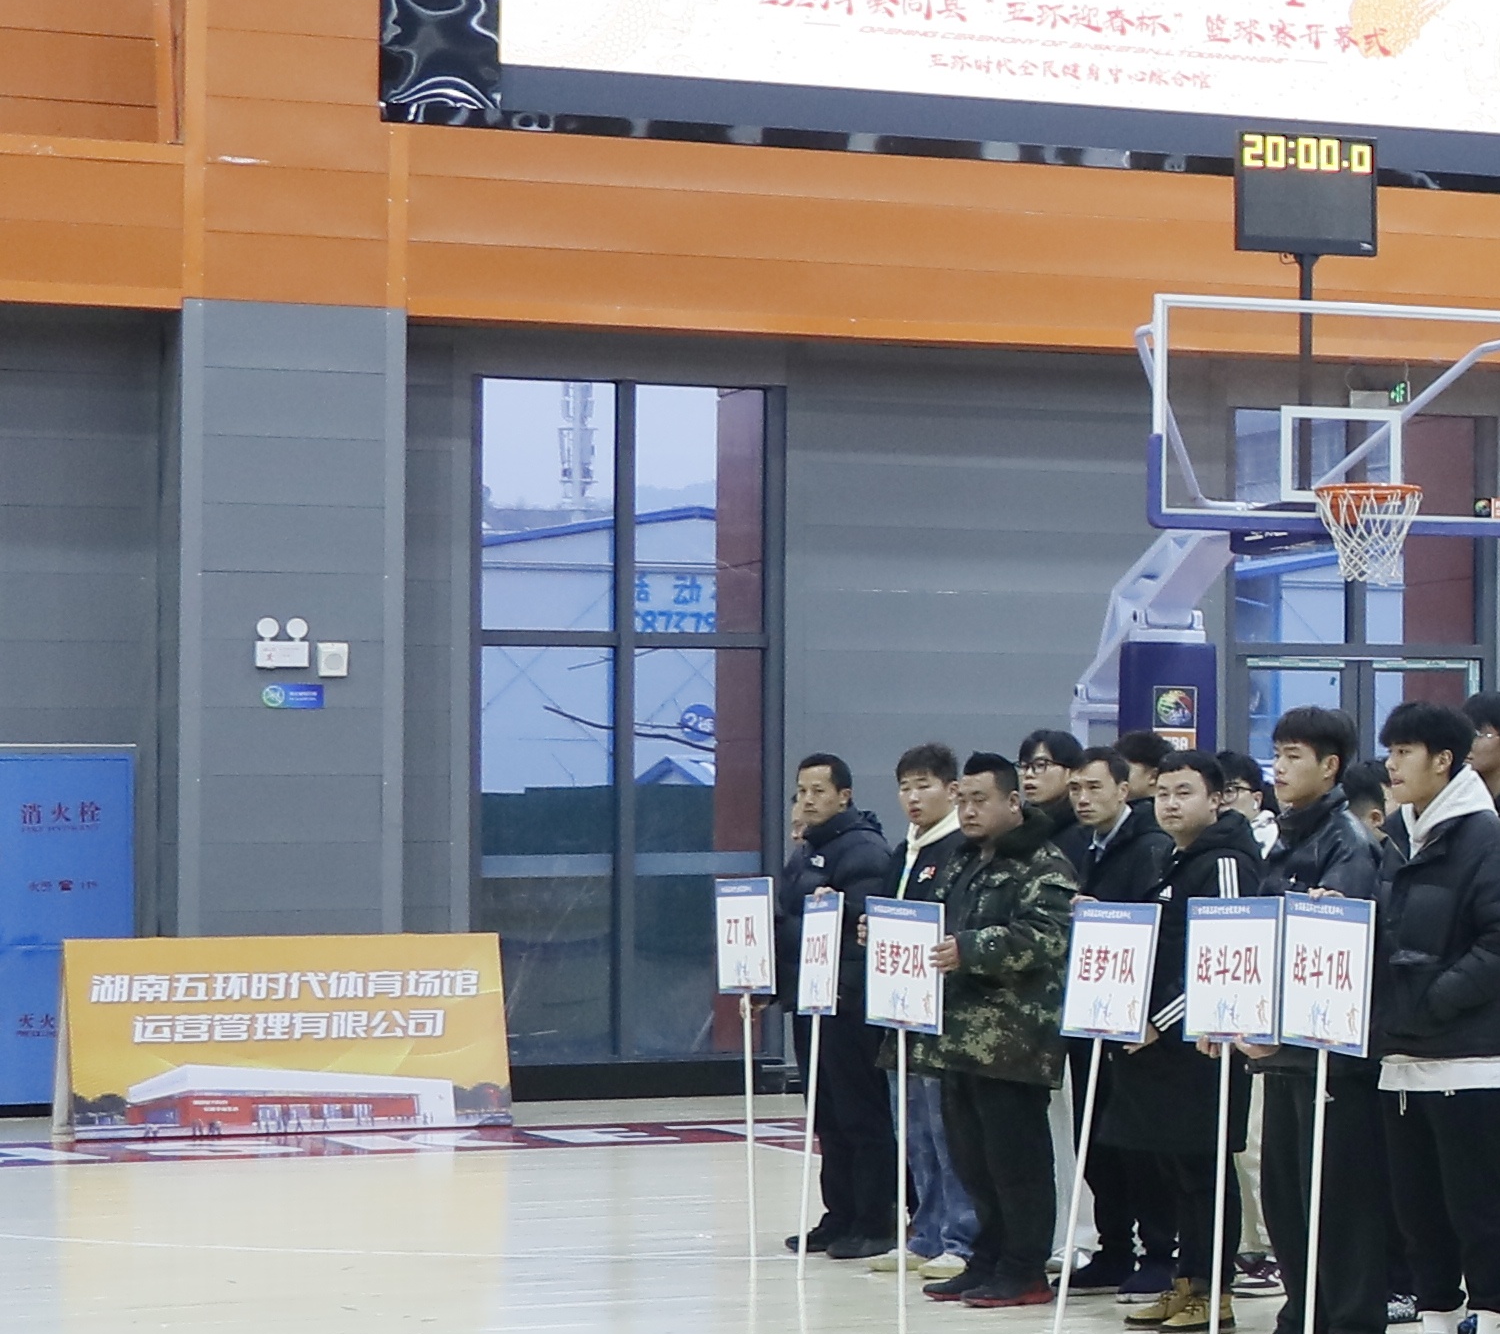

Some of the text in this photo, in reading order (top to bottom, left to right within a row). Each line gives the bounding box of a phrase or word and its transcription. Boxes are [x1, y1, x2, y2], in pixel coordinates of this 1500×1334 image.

[1242, 133, 1373, 174] 20:00.0
[875, 938, 928, 979] 追梦2队
[1077, 944, 1136, 984] 追梦1队
[1196, 944, 1262, 986] 战斗2队
[1293, 943, 1353, 991] 战斗1队
[89, 968, 481, 1005] 湖南五环时代体育场馆
[132, 1007, 446, 1045] 运营管理有限公司
